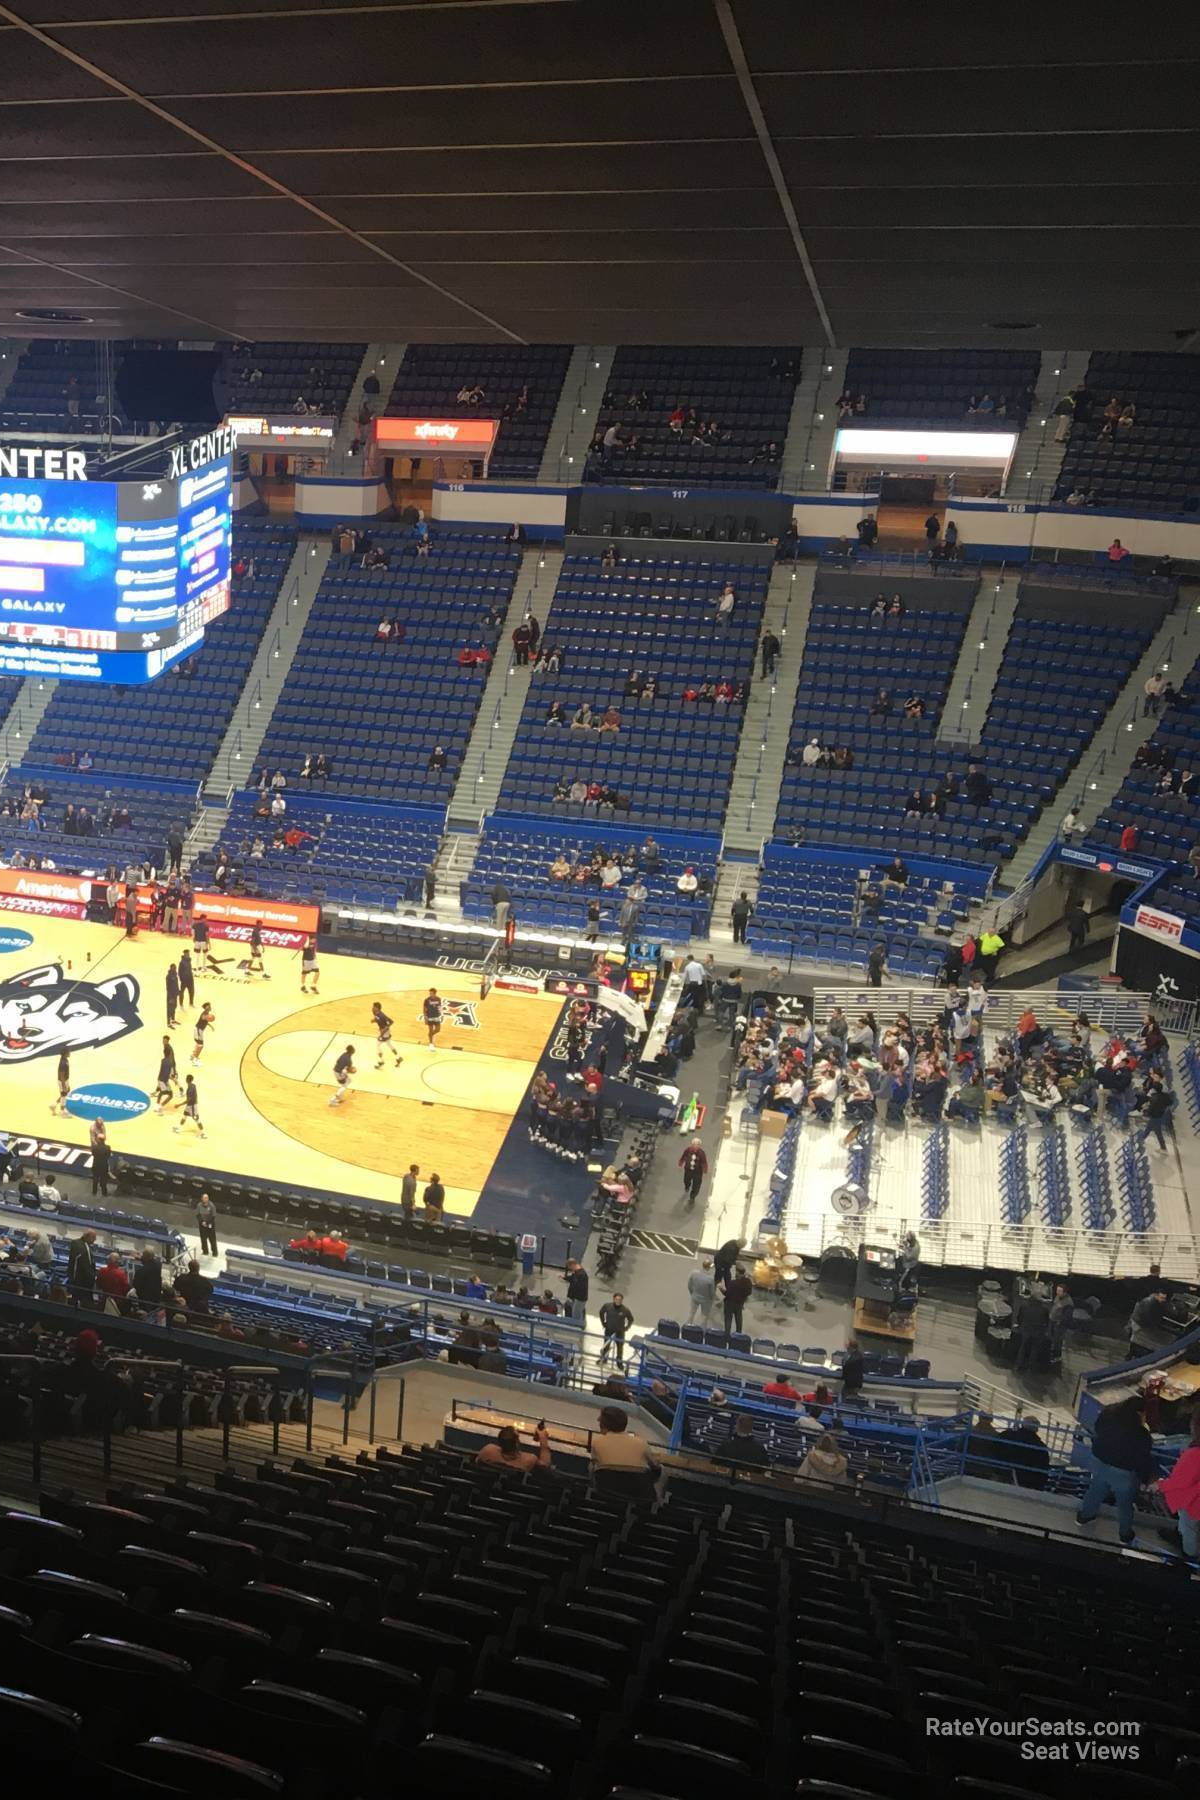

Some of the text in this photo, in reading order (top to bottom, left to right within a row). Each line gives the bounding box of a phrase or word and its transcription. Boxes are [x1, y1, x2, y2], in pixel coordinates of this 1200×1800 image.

[415, 422, 460, 439] xfinity
[170, 445, 188, 480] XL
[190, 424, 238, 470] CENTER
[672, 490, 689, 499] 117
[1, 598, 66, 613] GALAXY
[15, 878, 80, 901] Ameritas
[1137, 911, 1181, 937] ESPN
[228, 934, 289, 946] HELTH
[1157, 973, 1179, 993] XL
[776, 996, 804, 1014] XL
[67, 1093, 147, 1111] genius3D
